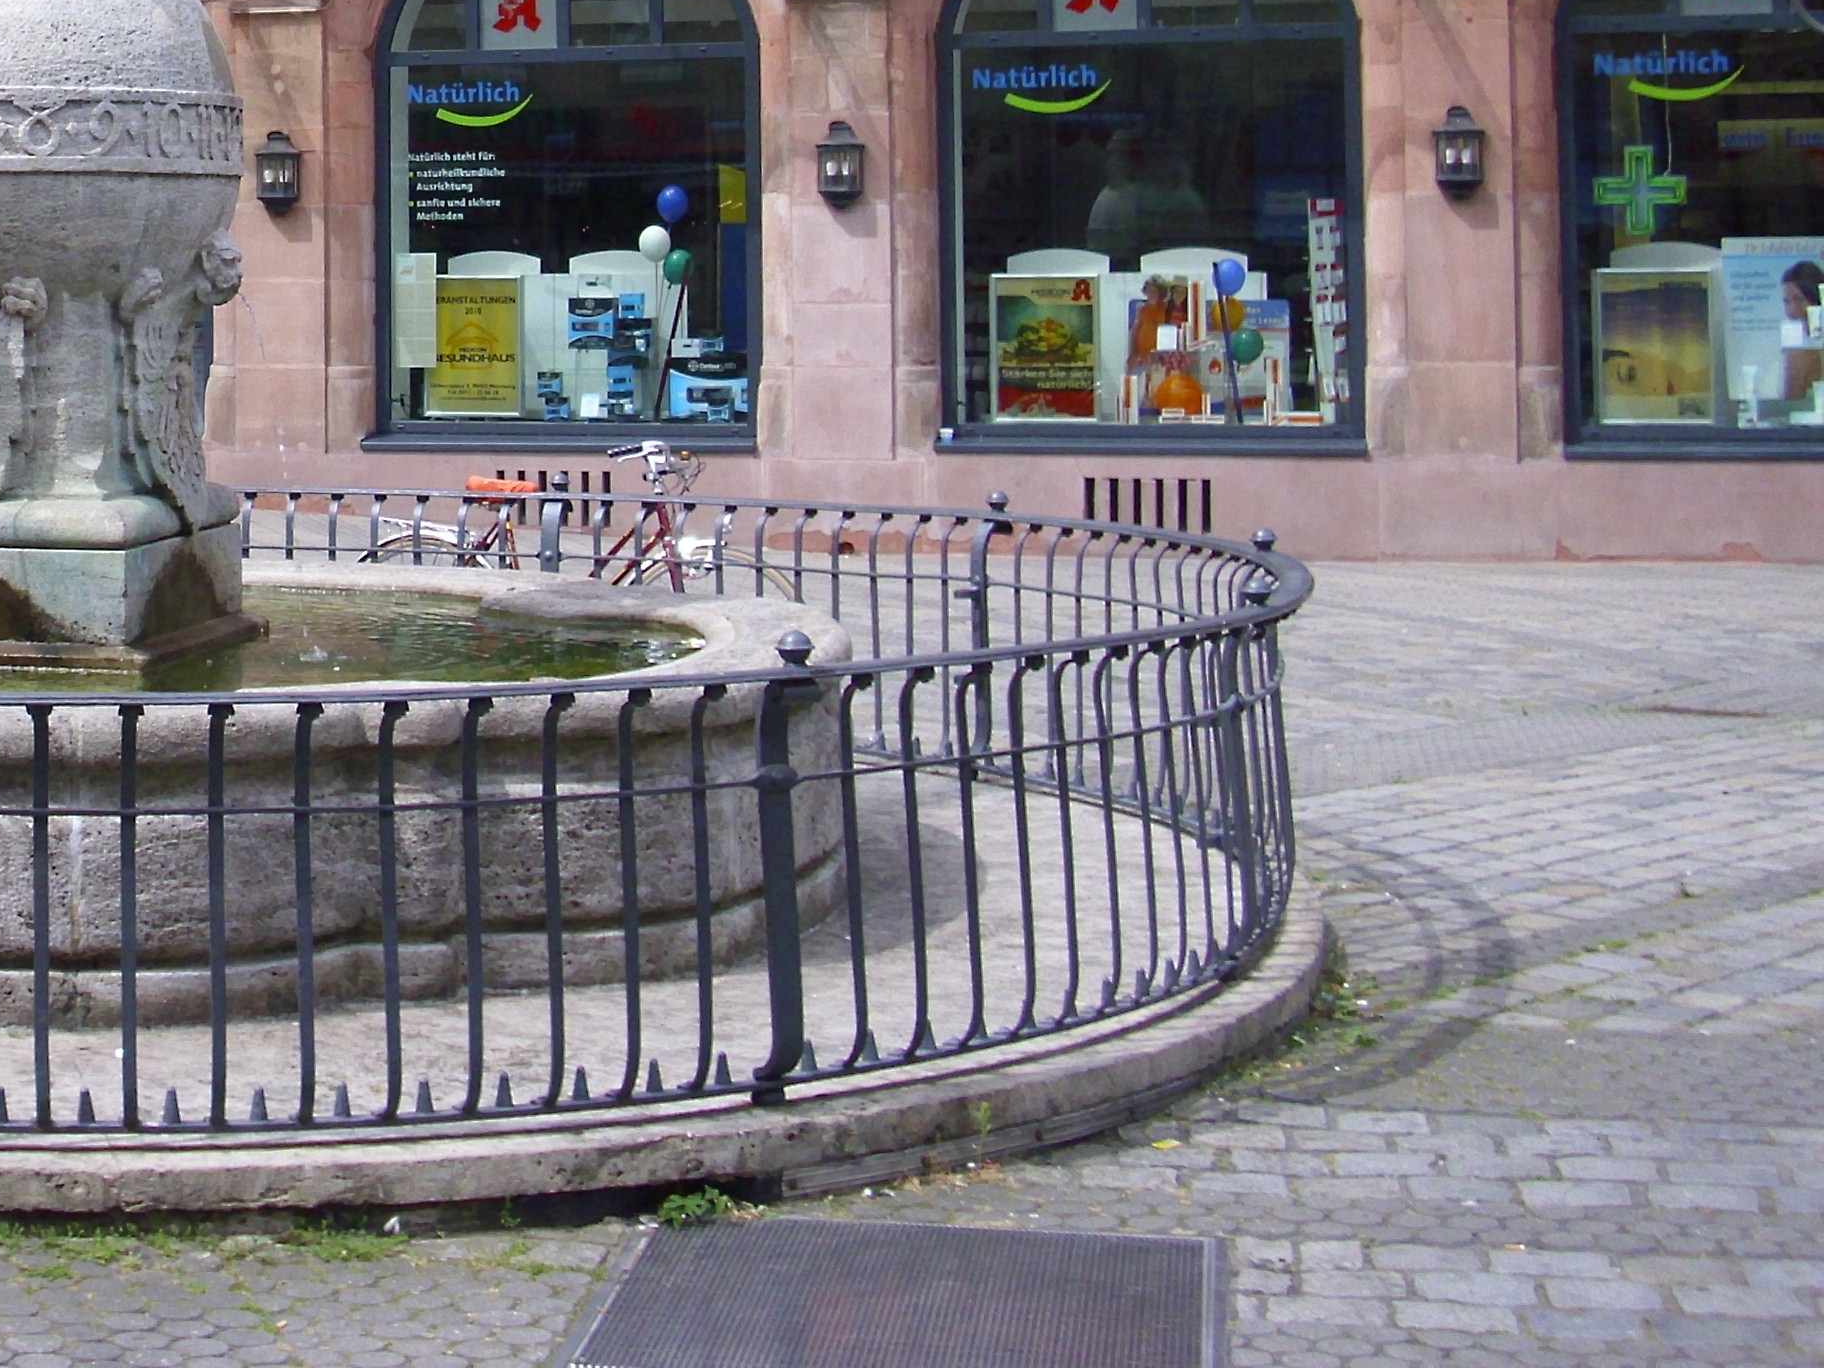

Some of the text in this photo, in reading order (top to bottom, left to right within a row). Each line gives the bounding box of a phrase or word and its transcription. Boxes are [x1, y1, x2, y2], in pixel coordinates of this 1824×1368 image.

[1593, 48, 1729, 75] Natürlich
[972, 64, 1096, 89] Natürlich
[407, 82, 519, 104] Natürlich
[14, 100, 66, 156] 8
[81, 101, 123, 157] 9
[408, 152, 450, 162] Natürlich
[452, 152, 475, 161] steht
[416, 167, 505, 177] naturheilkundliche
[416, 182, 473, 193] Ausrichtung
[416, 198, 501, 207] sanfte und sichere
[416, 211, 464, 221] Methoden
[436, 295, 516, 305] ERANSTALTUNGEN
